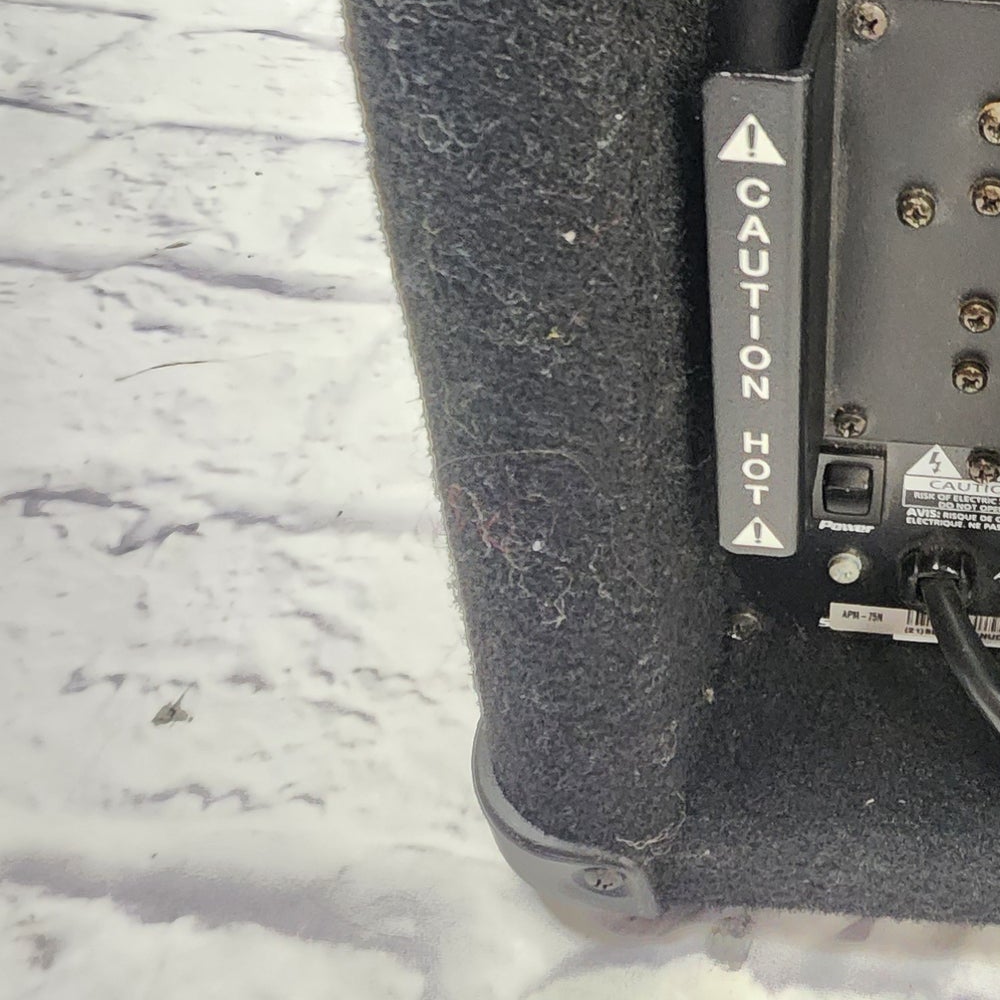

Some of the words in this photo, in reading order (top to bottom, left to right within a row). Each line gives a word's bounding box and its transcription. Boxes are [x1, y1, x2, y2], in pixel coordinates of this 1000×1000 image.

[736, 177, 772, 400] CAUTION
[741, 431, 771, 506] HOT
[914, 491, 936, 500] RISK
[937, 493, 952, 501] OF
[953, 494, 998, 505] ELECTRIC
[938, 501, 955, 509] DO
[956, 502, 978, 512] NOT
[906, 507, 941, 518] AVIS:
[943, 511, 978, 521] RISQUE
[980, 514, 993, 522] DE
[818, 520, 875, 534] Power
[968, 521, 982, 530] NE
